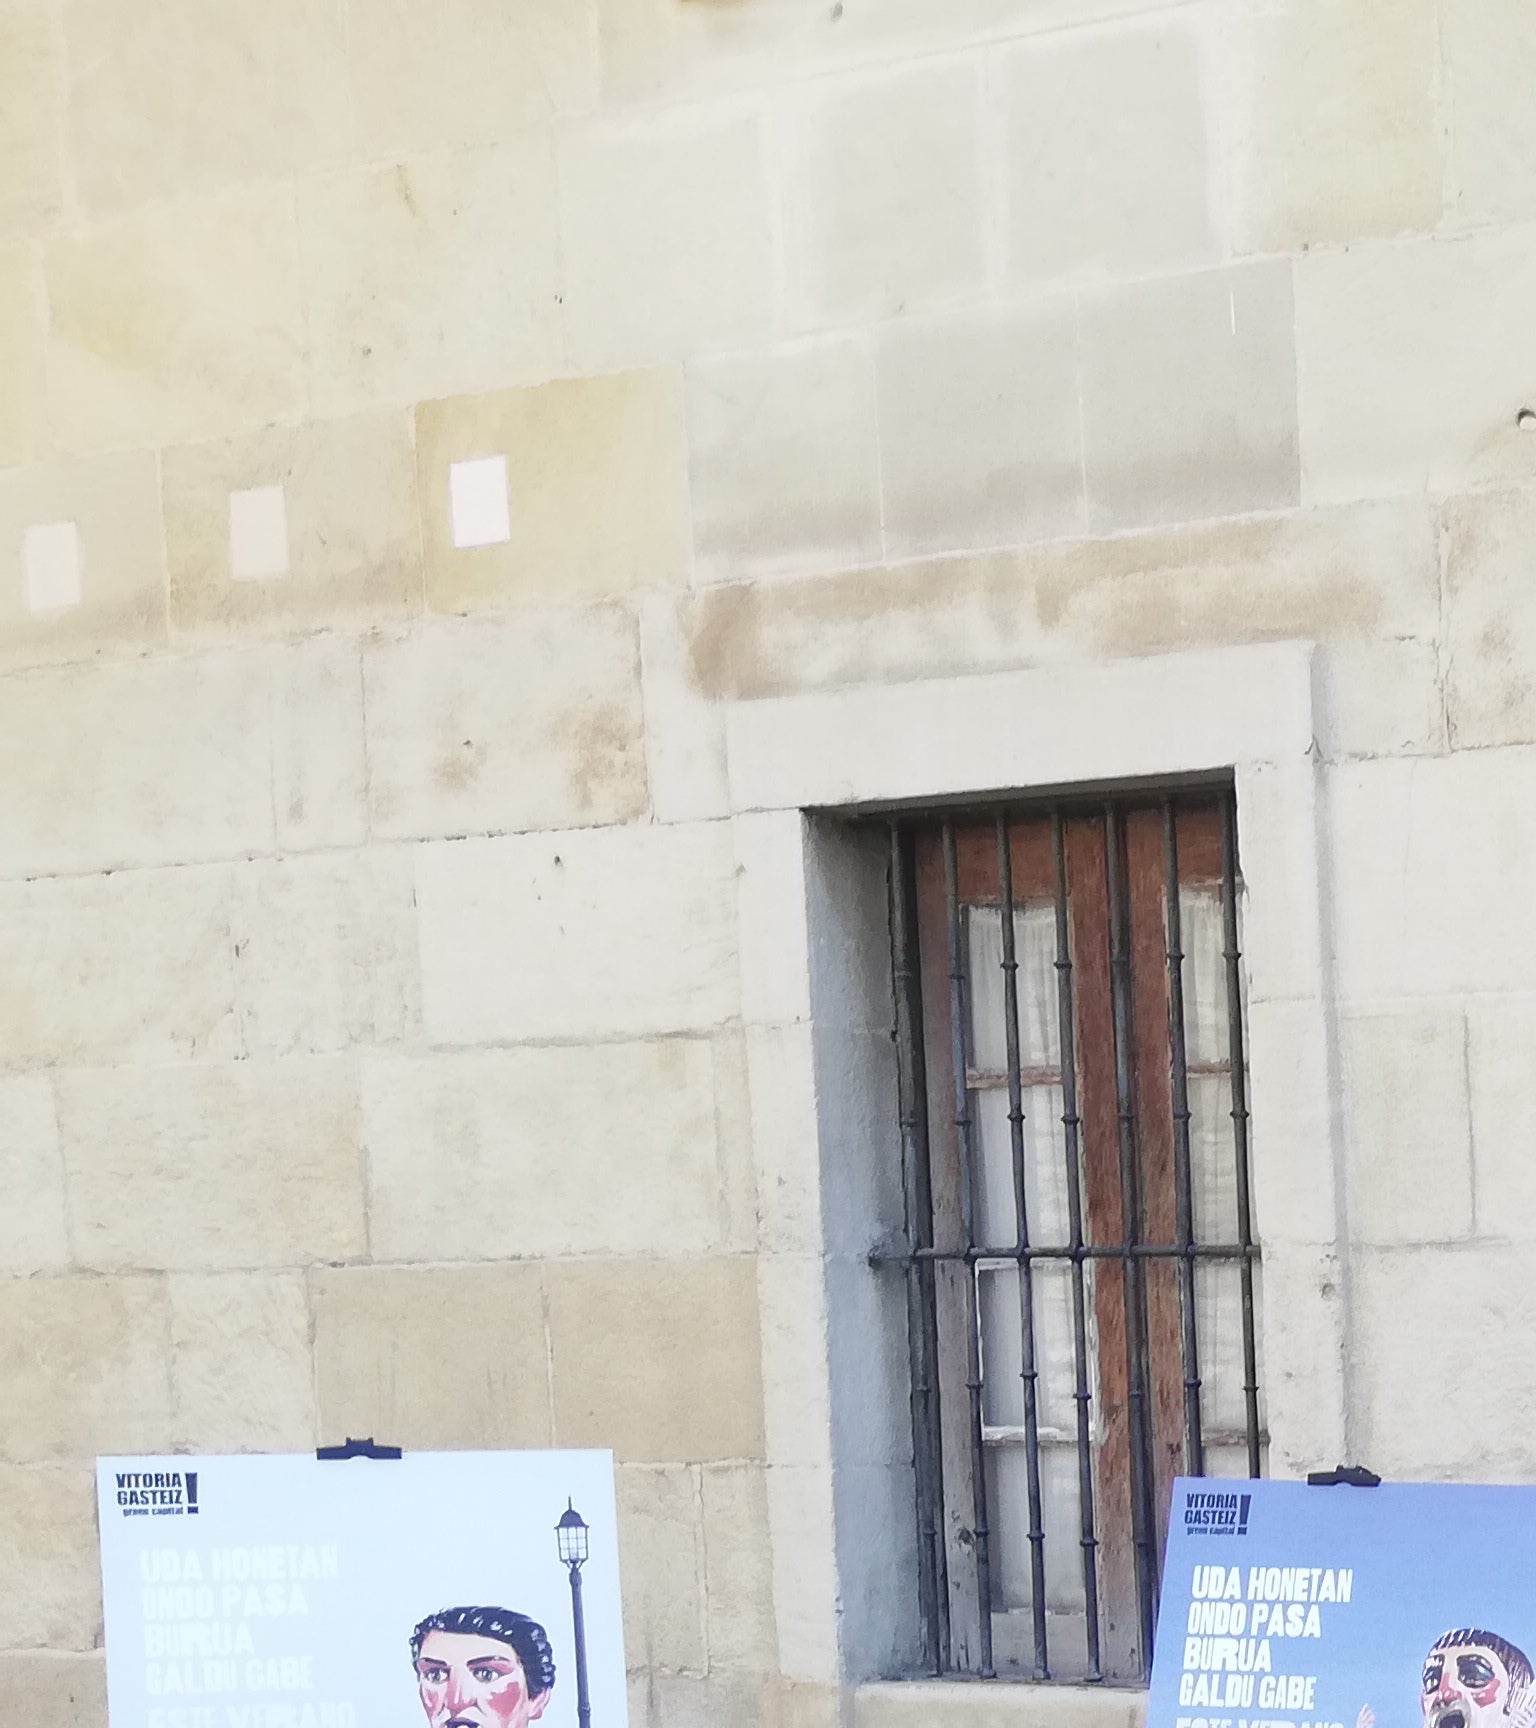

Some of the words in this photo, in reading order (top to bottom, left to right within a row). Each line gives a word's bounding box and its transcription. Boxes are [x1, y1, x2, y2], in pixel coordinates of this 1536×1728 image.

[116, 1473, 182, 1488] VITORIA
[117, 1489, 182, 1505] GASTEIZ
[1184, 1510, 1236, 1525] GASTEIZ
[1186, 1493, 1237, 1508] VITORIA
[140, 1547, 203, 1582] UDA
[212, 1543, 338, 1580] HONETAN
[222, 1582, 308, 1617] PASA
[1192, 1565, 1241, 1600] UDA
[1248, 1567, 1353, 1603] HONETAN
[1187, 1602, 1247, 1635] ONDO
[1251, 1603, 1321, 1638] PASA
[1183, 1637, 1271, 1672] BURUA
[145, 1659, 237, 1695] GALDU
[245, 1656, 315, 1691] GABE
[1179, 1673, 1254, 1708] GALDU
[1259, 1675, 1317, 1710] GABE
